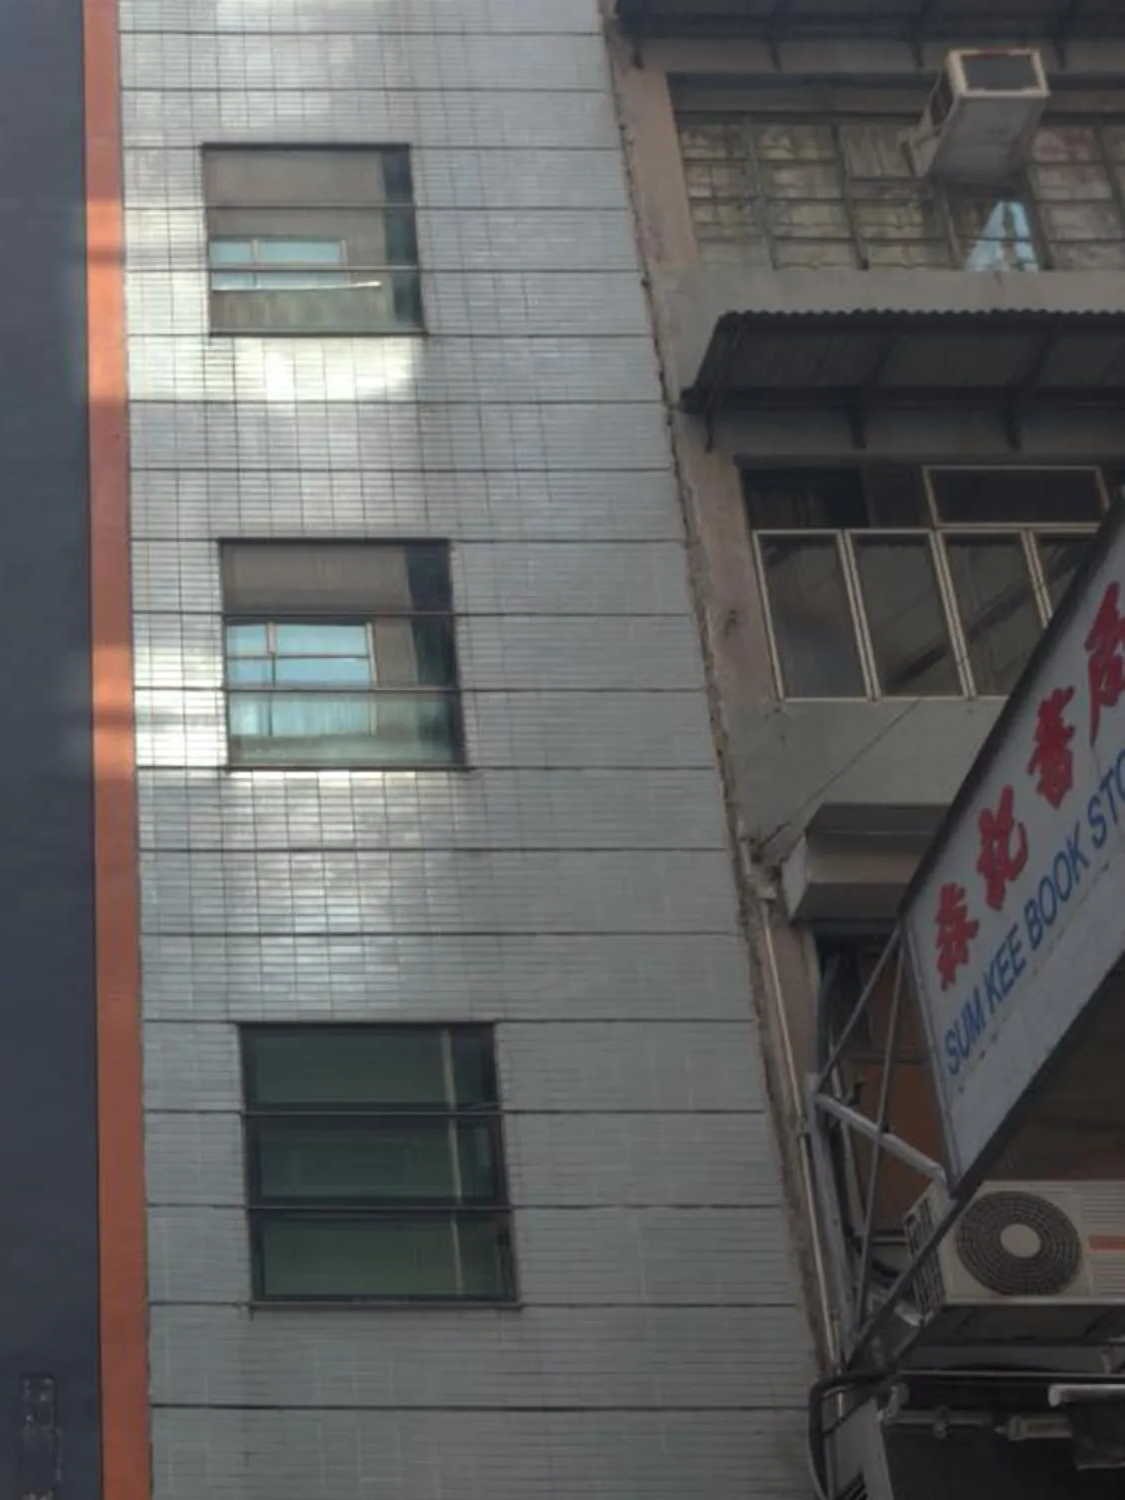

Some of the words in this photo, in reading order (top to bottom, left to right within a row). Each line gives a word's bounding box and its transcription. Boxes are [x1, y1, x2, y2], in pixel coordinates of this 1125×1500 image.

[944, 987, 987, 1075] SUM
[984, 922, 1027, 1014] KEE
[1024, 820, 1089, 950] BOOK
